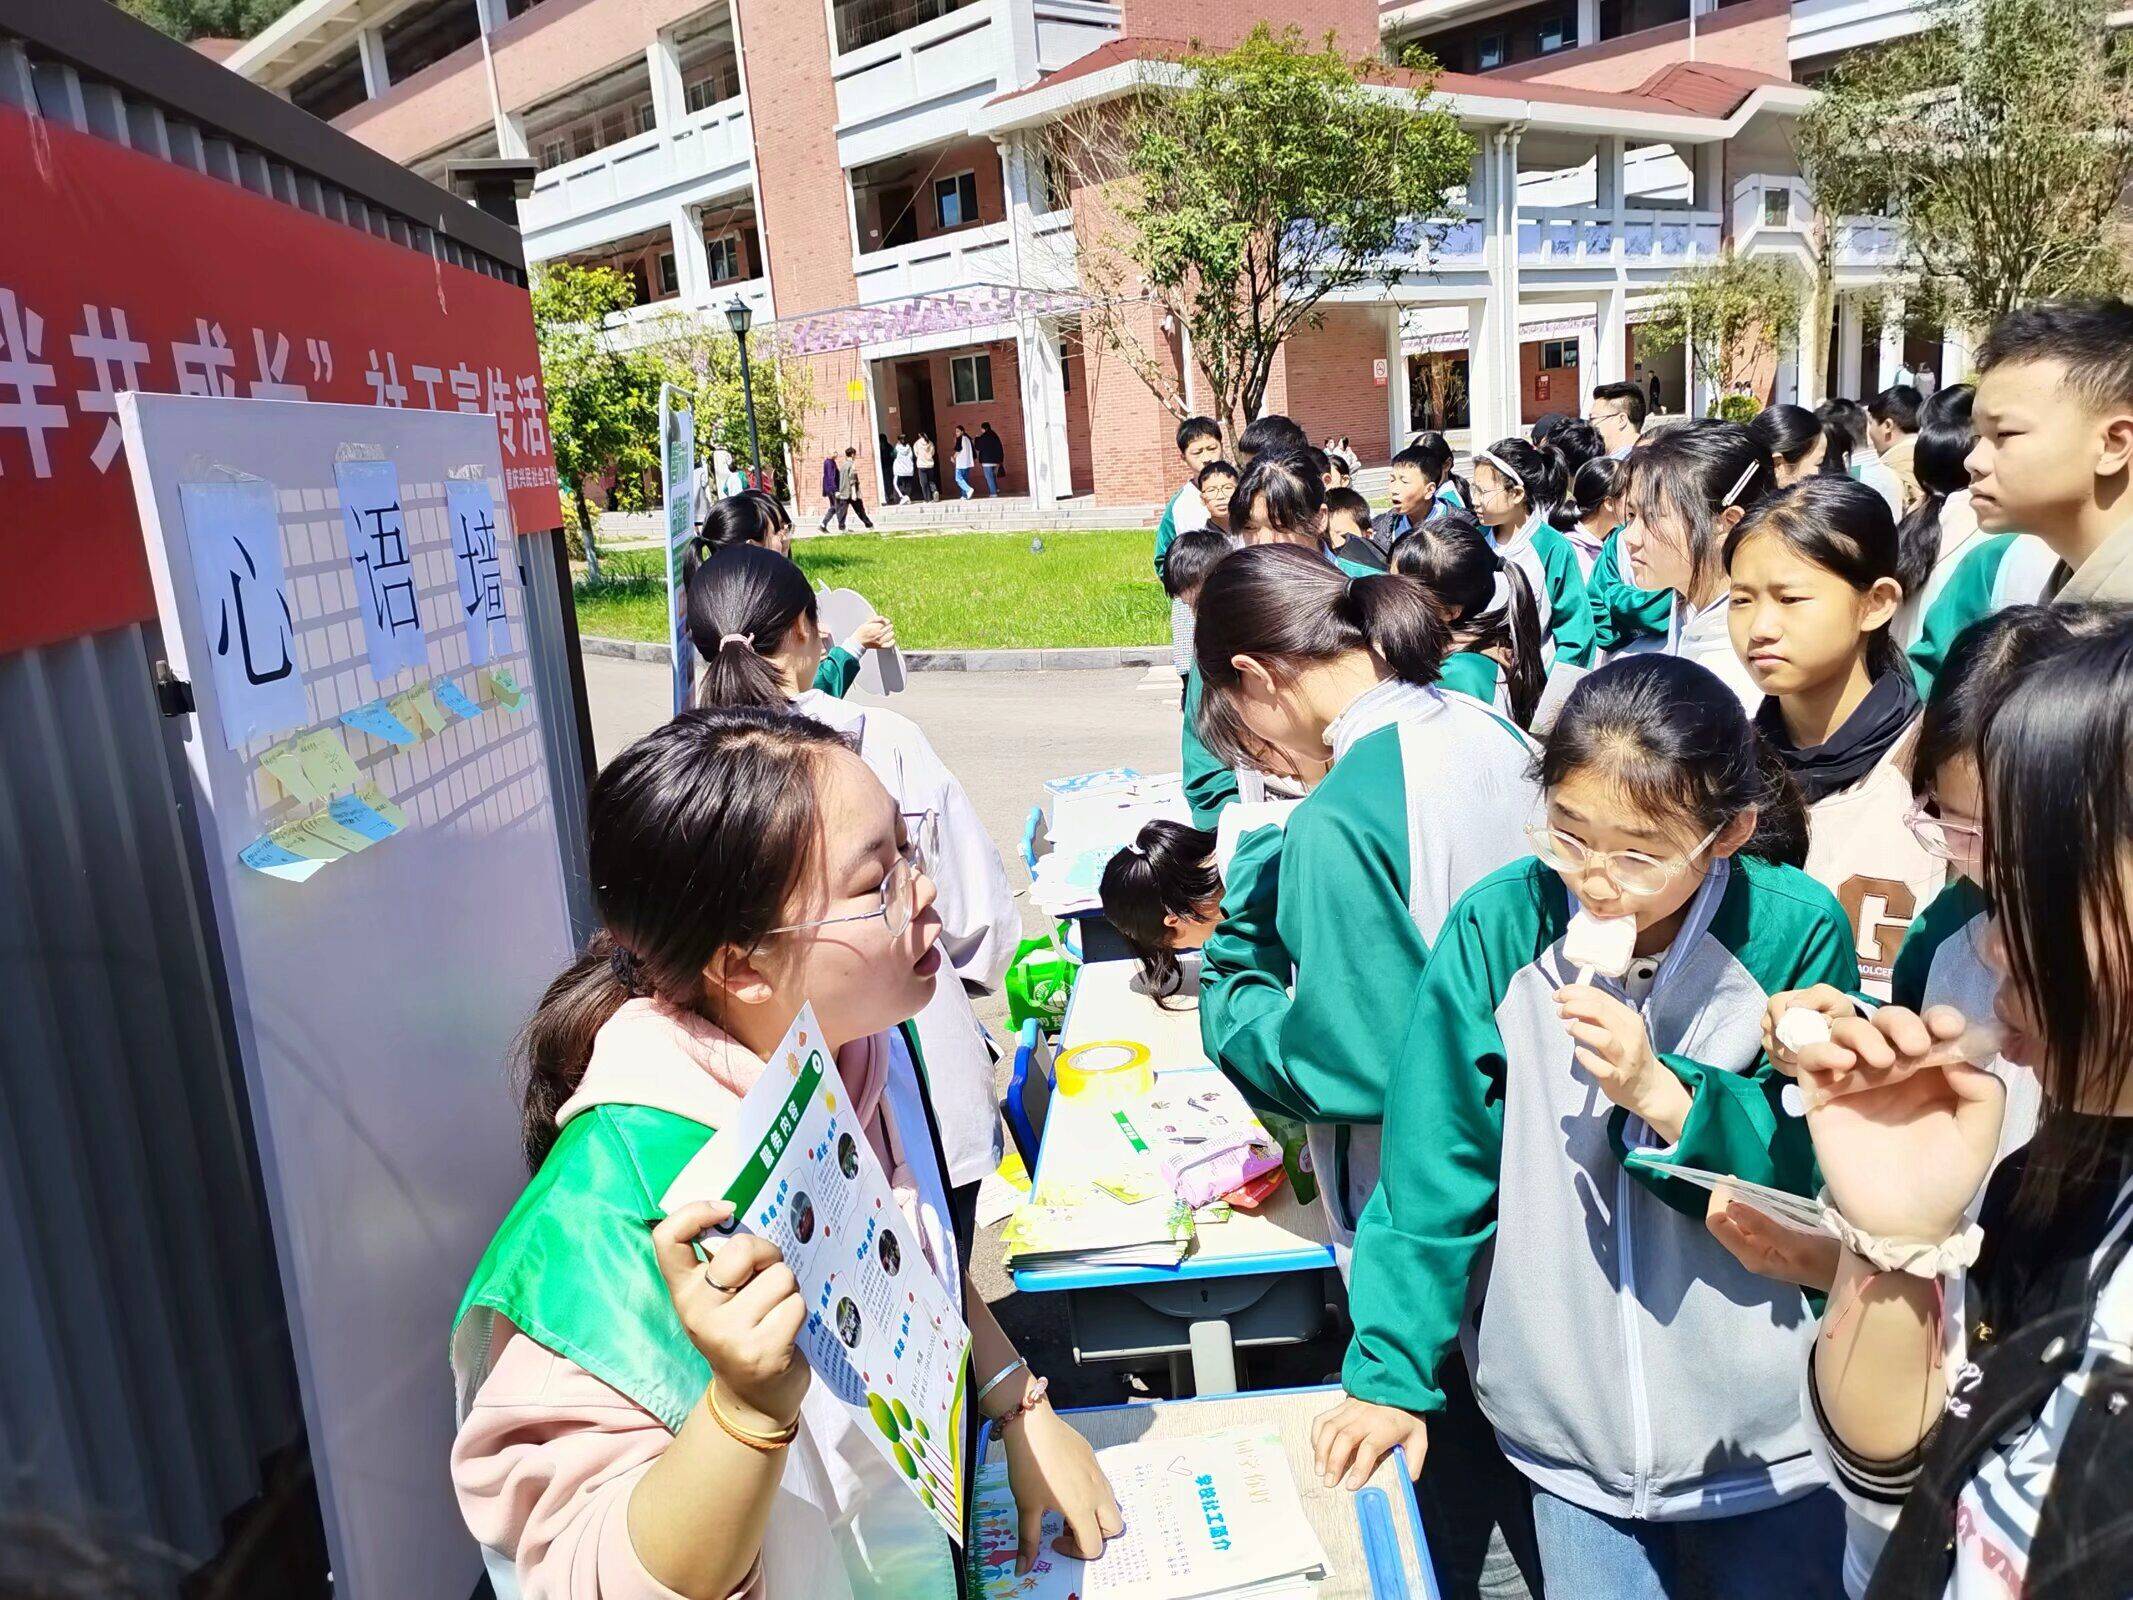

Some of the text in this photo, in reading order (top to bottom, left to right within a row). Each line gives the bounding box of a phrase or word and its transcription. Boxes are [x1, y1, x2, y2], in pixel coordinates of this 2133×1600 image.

[1838, 874, 1916, 980] G
[759, 1099, 801, 1170] 服务内容
